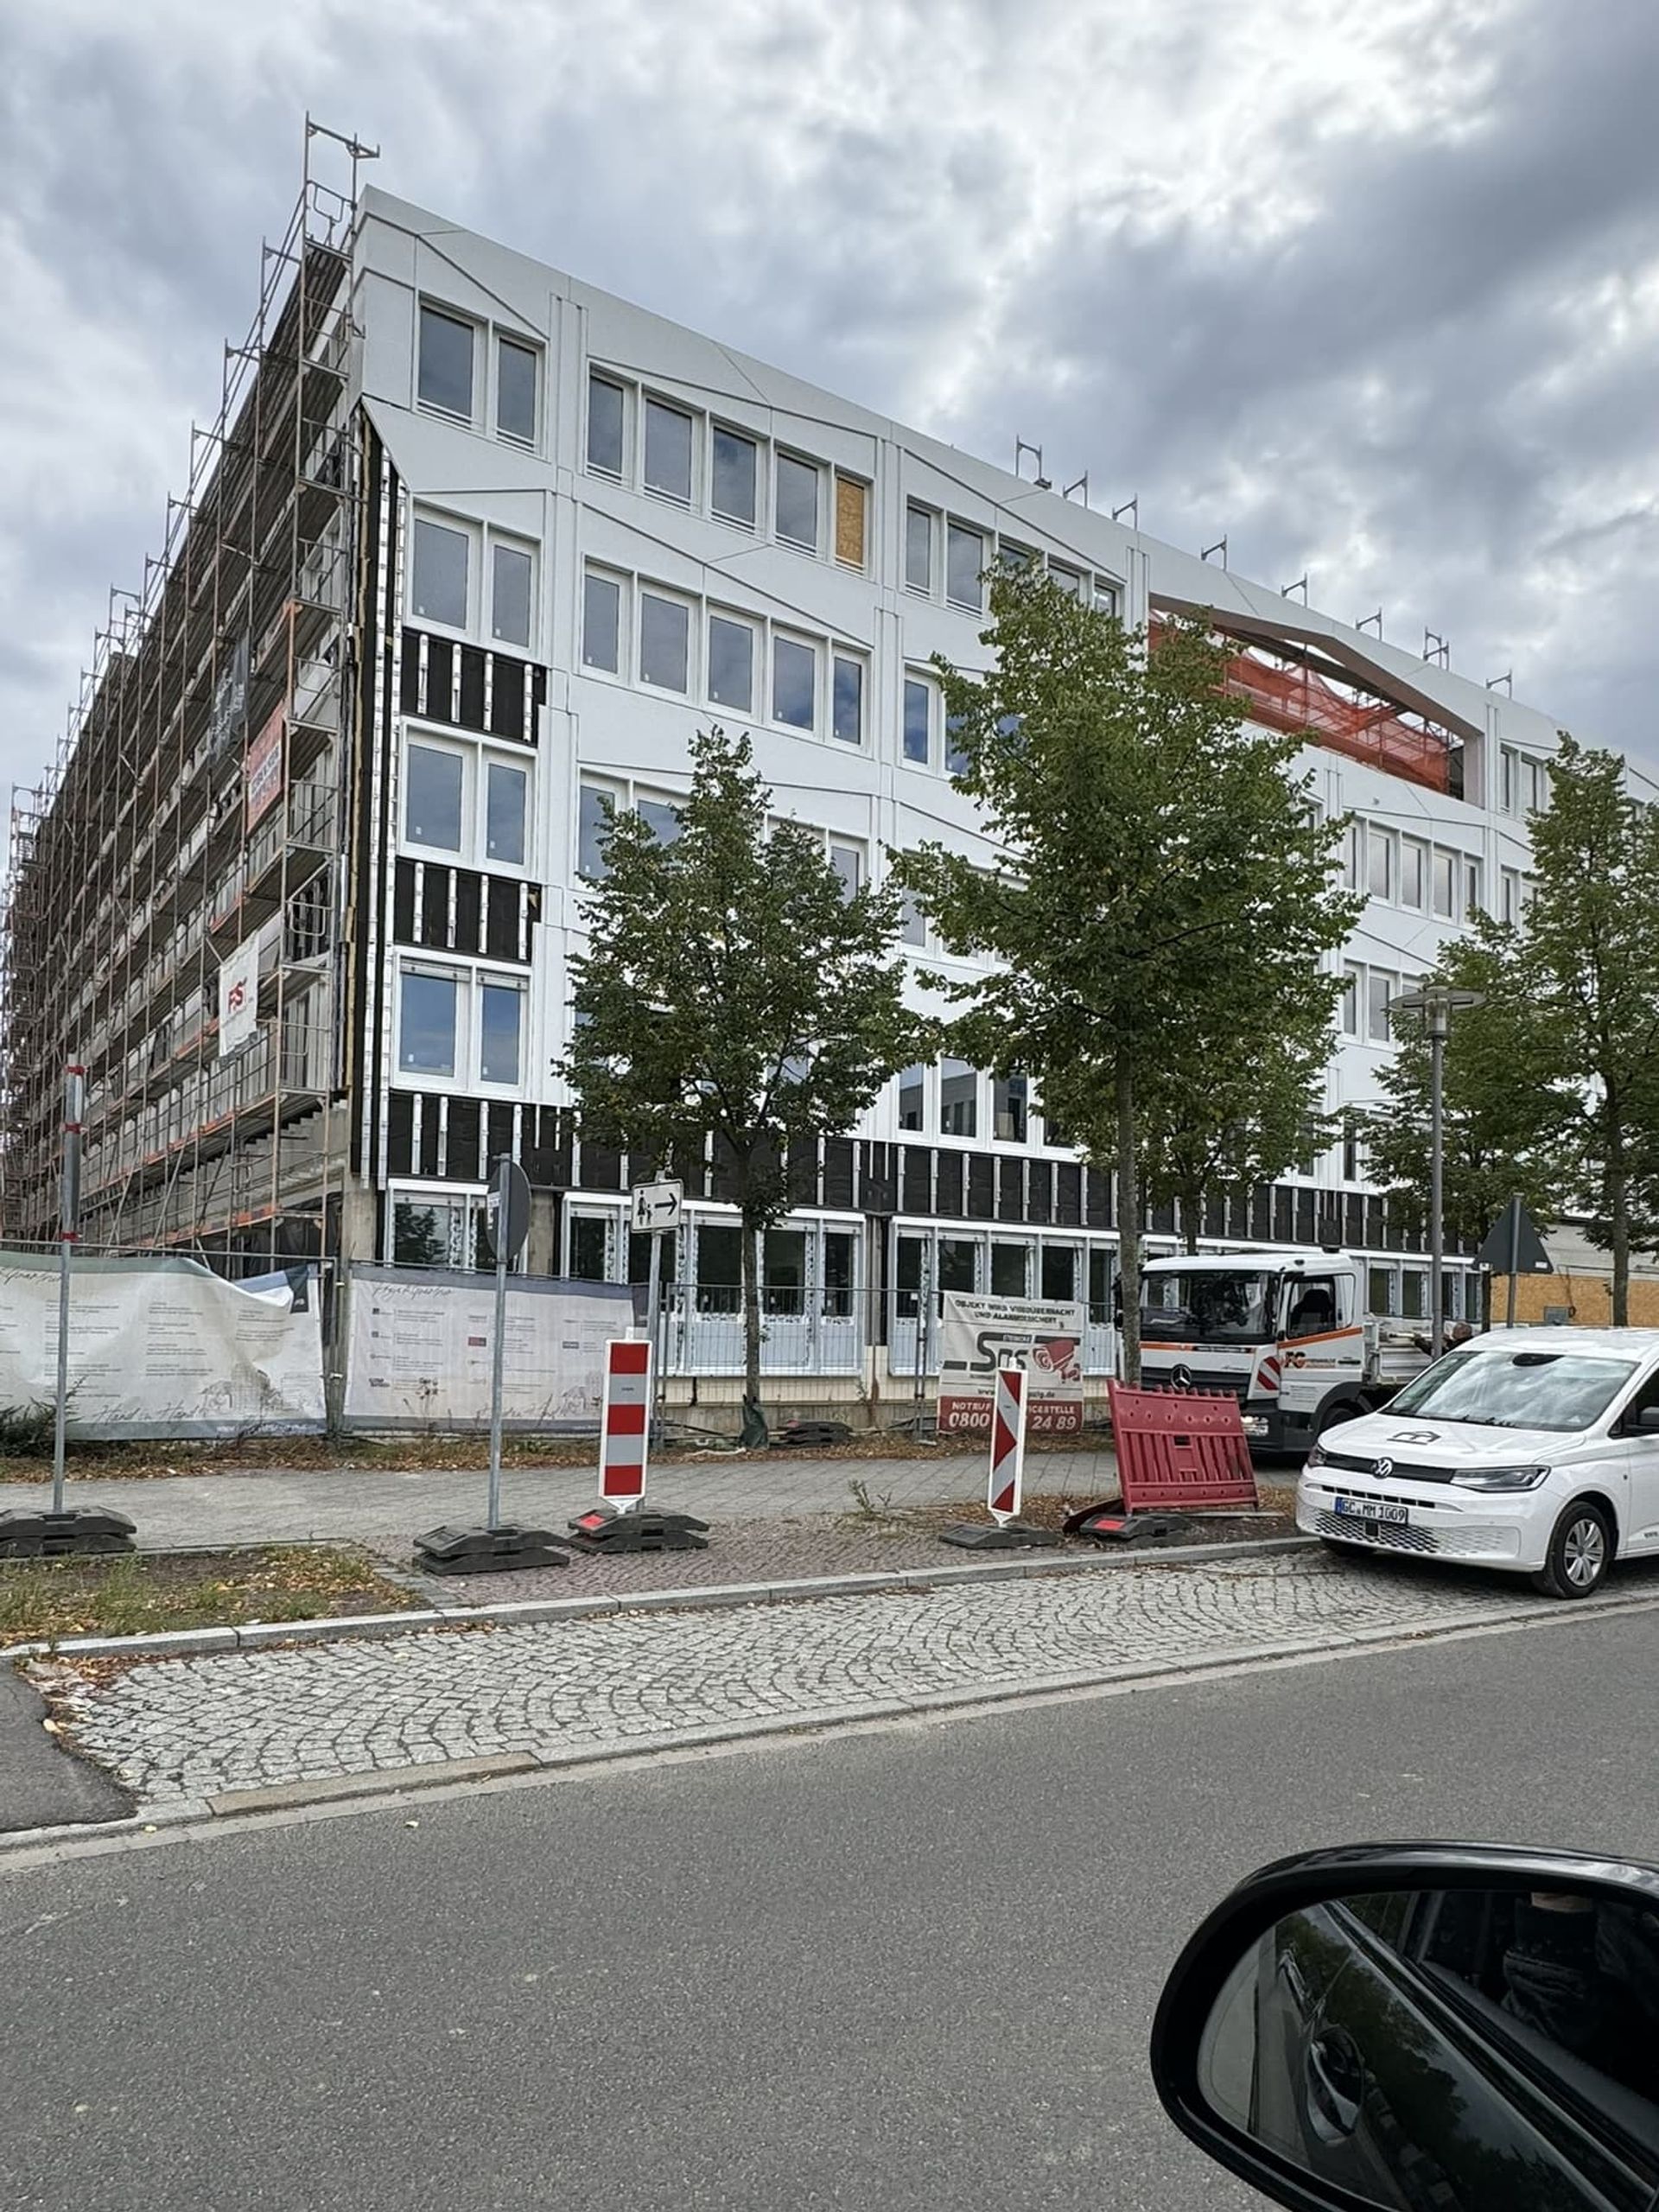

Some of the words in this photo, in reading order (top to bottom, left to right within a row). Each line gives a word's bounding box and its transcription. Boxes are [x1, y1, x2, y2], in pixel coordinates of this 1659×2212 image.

[952, 1402, 992, 1411] NOTRUF
[949, 1412, 991, 1427] 0800
[1032, 1415, 1053, 1429] 24
[1056, 1415, 1077, 1430] 89
